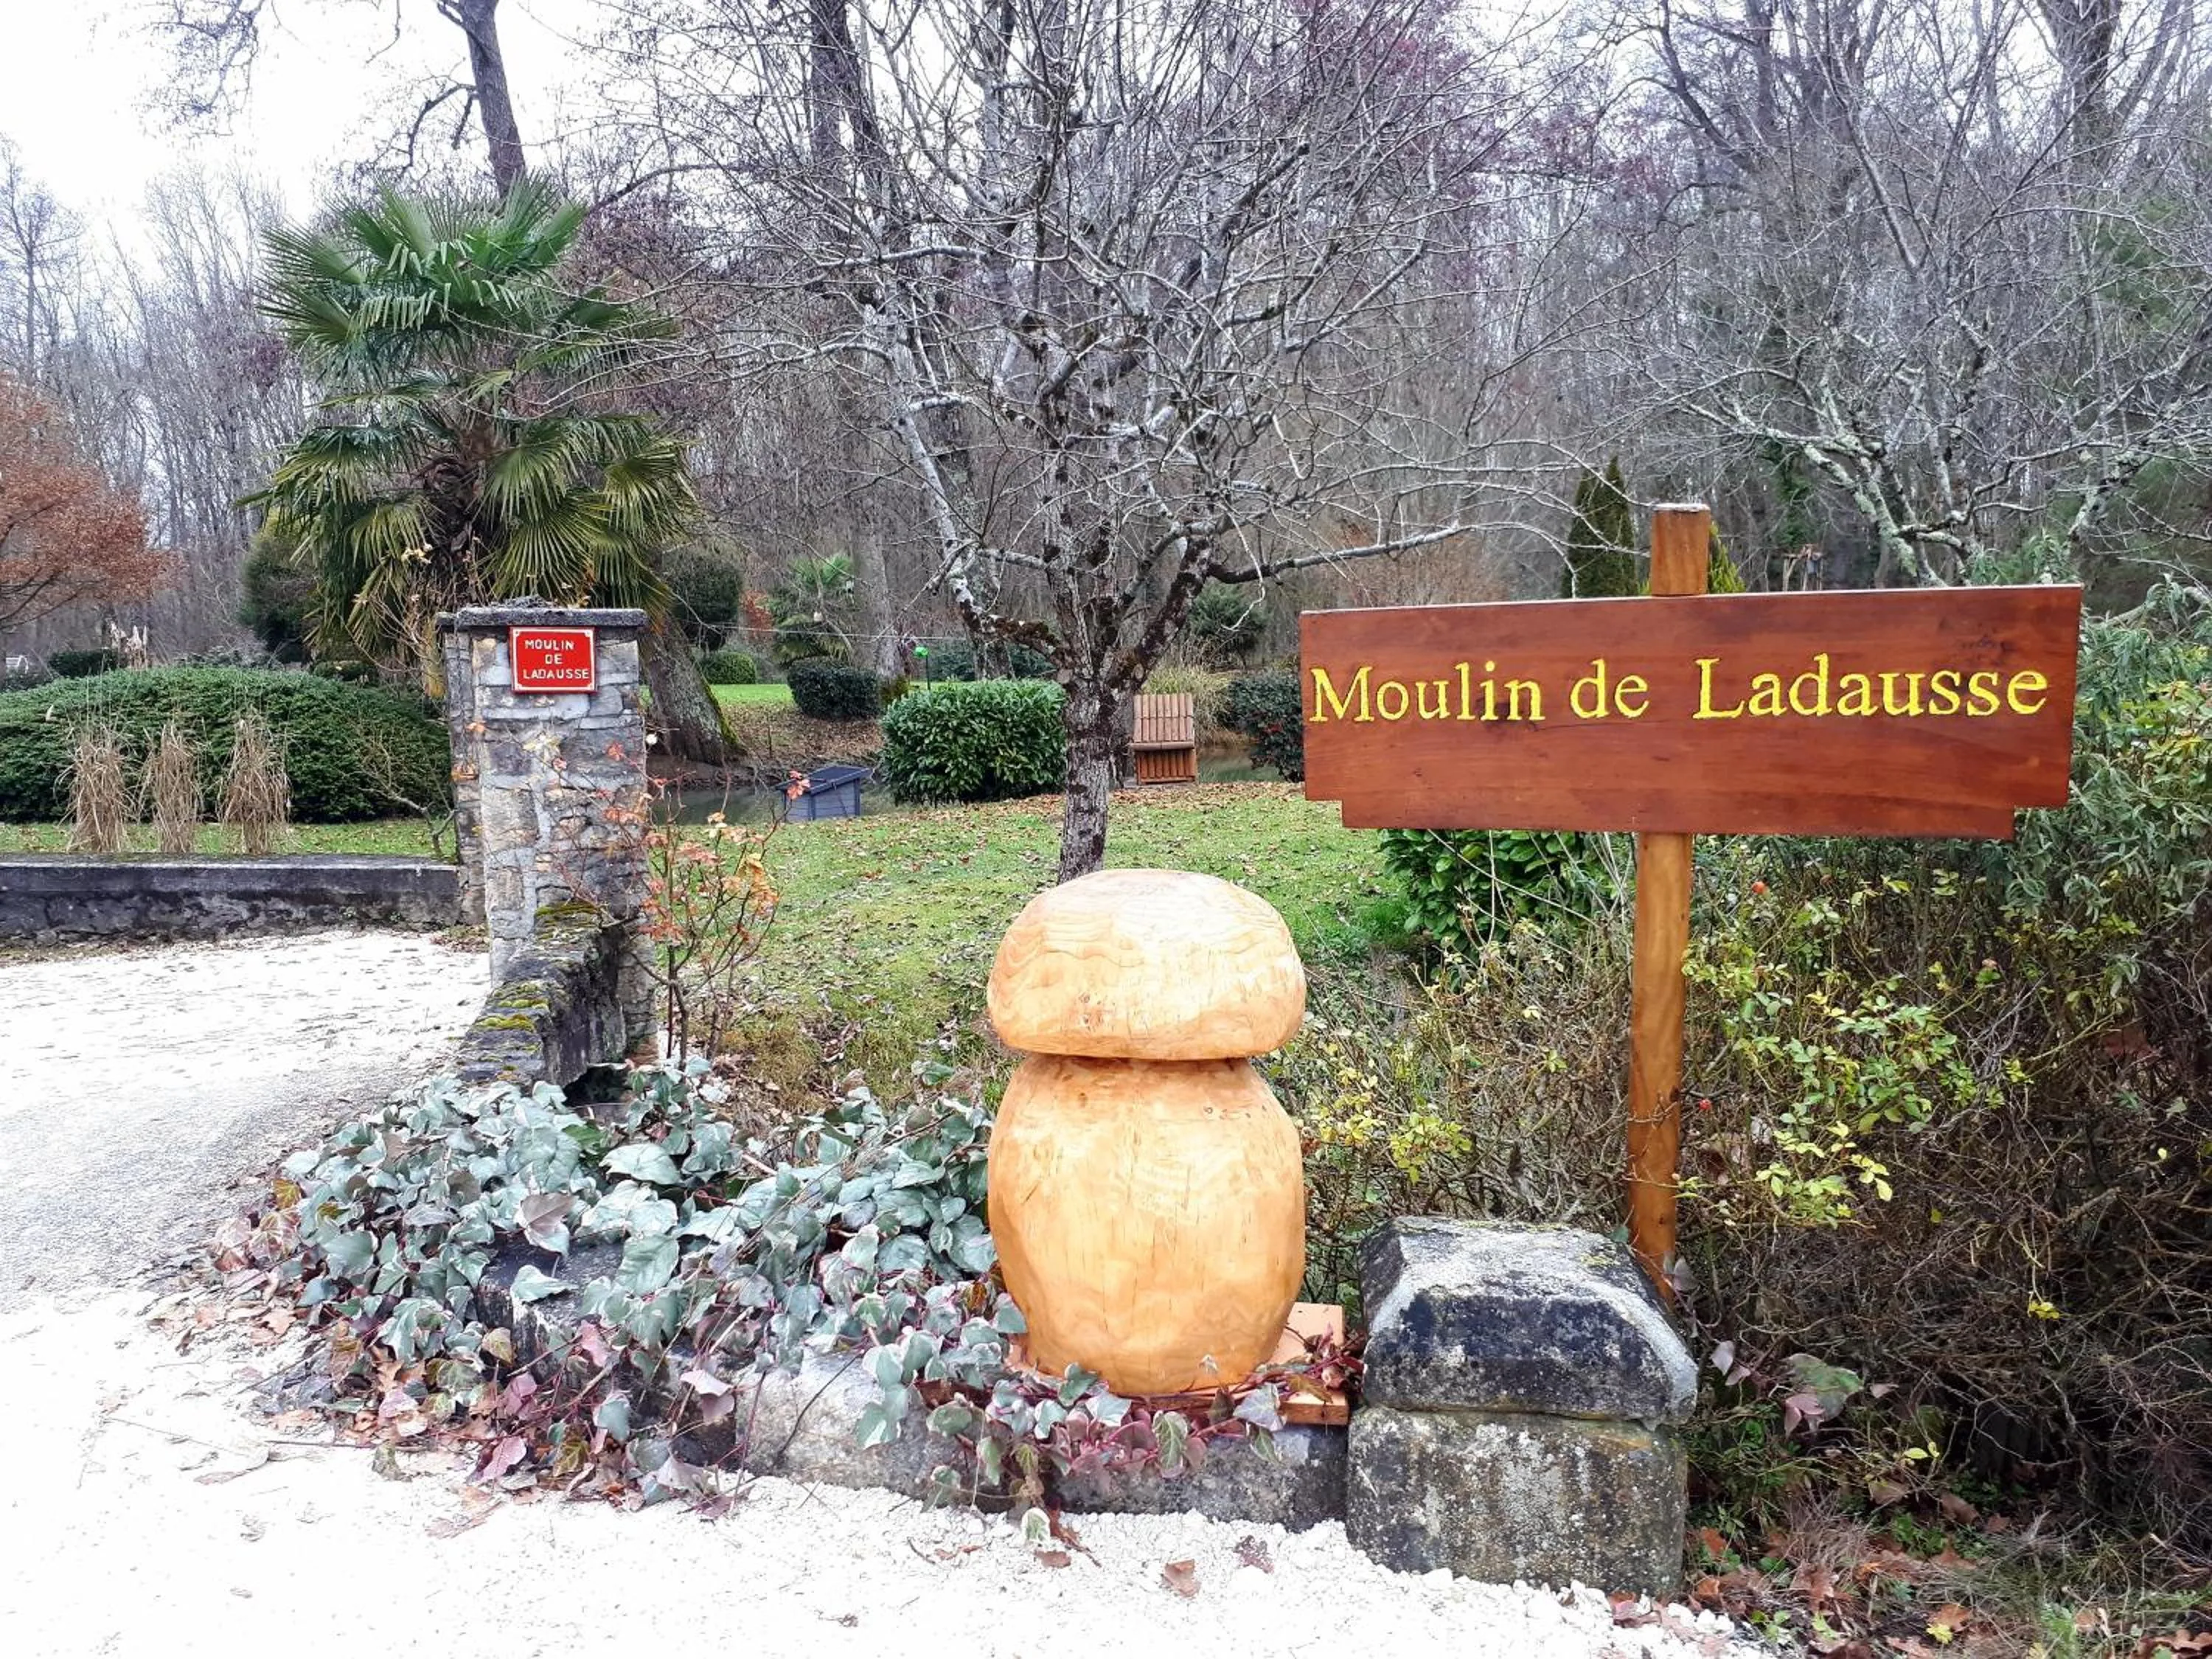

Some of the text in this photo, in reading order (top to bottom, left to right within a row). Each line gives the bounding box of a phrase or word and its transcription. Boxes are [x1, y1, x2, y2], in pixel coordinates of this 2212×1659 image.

[524, 639, 574, 650] MOULIN
[545, 653, 563, 664] DE
[523, 669, 590, 679] LADAUSSE
[1310, 653, 2049, 722] Moulin de Ladausse
